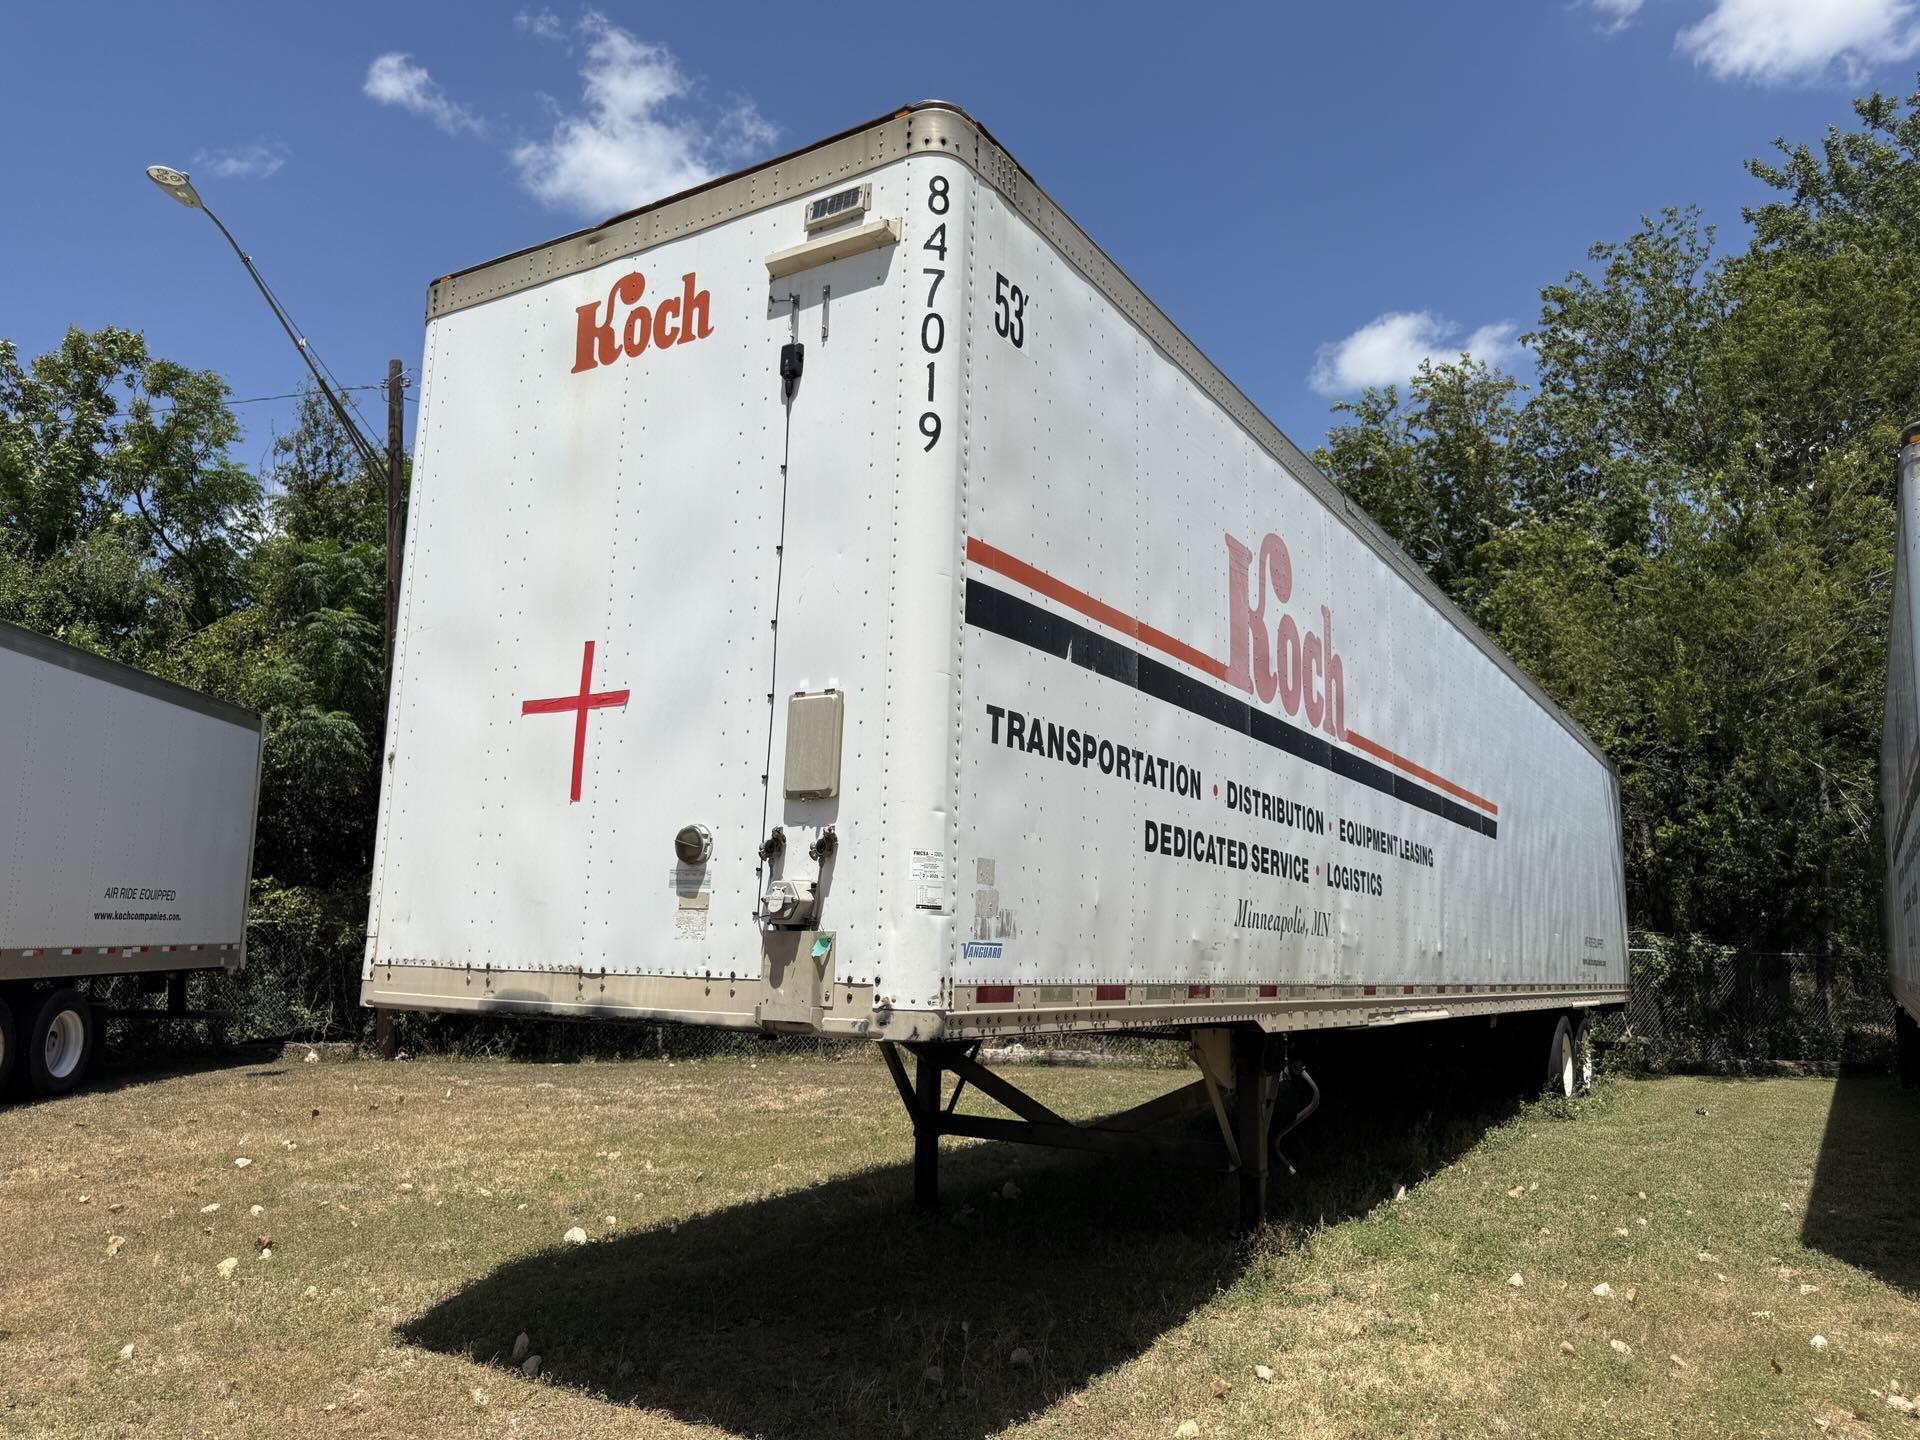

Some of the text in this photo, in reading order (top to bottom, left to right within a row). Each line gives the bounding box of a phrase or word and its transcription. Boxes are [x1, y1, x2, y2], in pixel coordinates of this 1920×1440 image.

[571, 271, 715, 374] Koch
[919, 175, 950, 453] 847019
[1224, 532, 1348, 742] Koch
[986, 703, 1434, 868] TRANSPORTATION DISTRIBUTION EQUIPMENT LEASING
[104, 887, 177, 901] AIR RIDE EQUIPPED
[1145, 820, 1383, 897] DEDICATED SERVICE LOGISTICS
[960, 942, 1003, 960] VANGUARD
[1234, 898, 1332, 941] Minneapolis, MN
